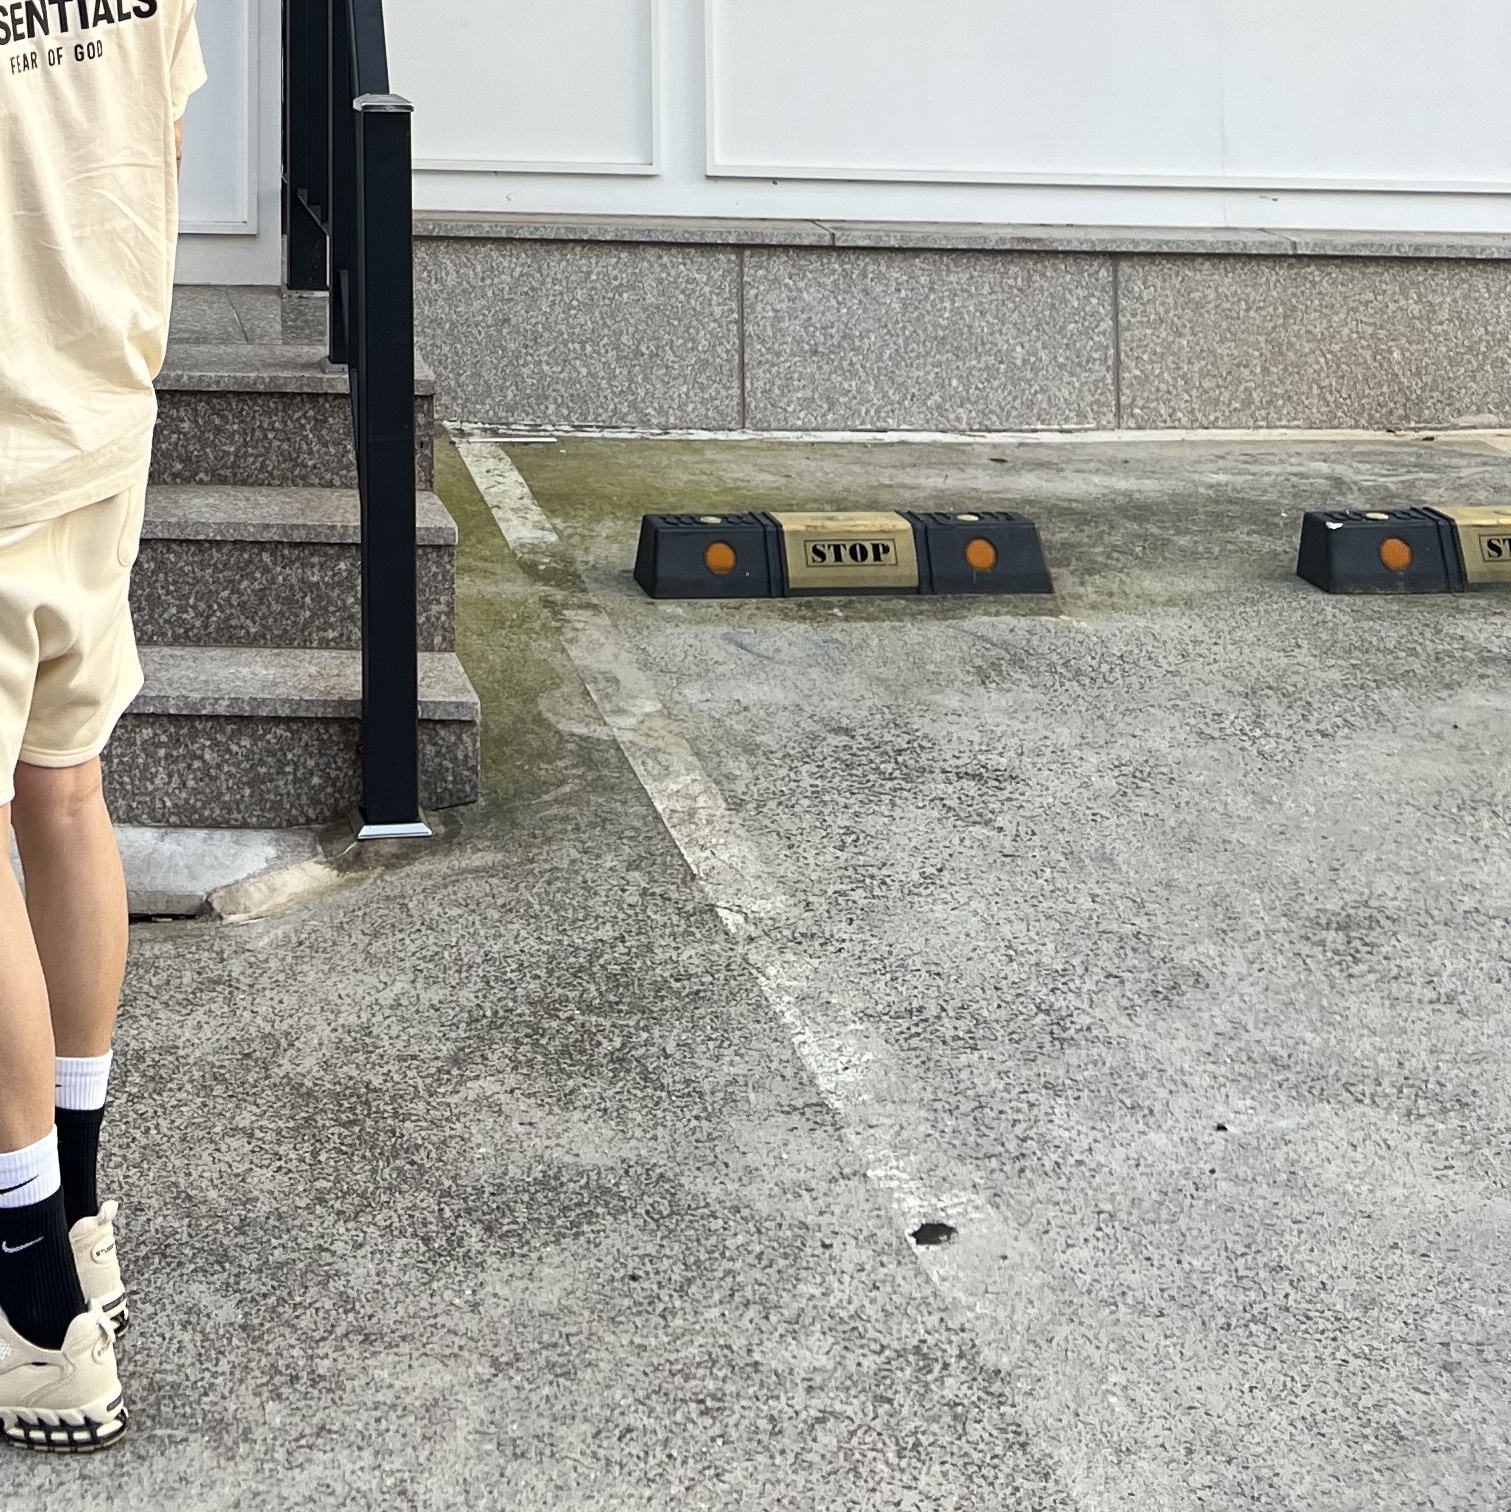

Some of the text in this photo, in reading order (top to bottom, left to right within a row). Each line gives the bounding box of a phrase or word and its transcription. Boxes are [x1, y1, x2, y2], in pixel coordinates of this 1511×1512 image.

[10, 39, 104, 76] FEAR OF GOD
[811, 542, 891, 564] STOP
